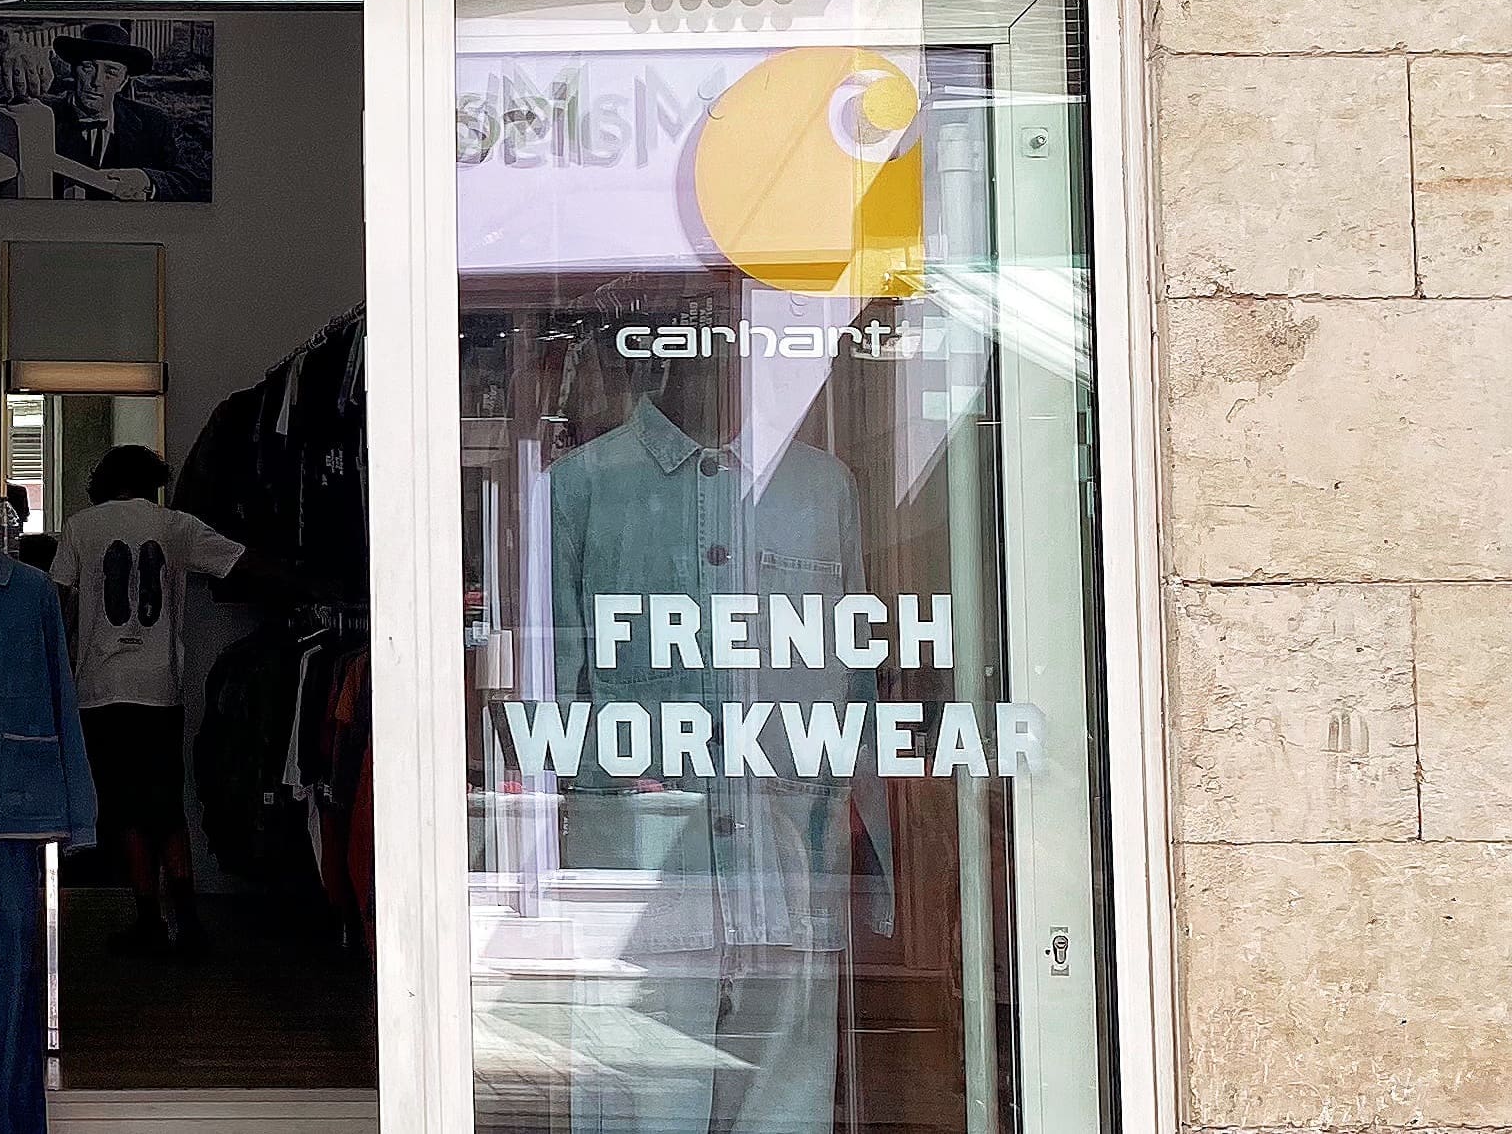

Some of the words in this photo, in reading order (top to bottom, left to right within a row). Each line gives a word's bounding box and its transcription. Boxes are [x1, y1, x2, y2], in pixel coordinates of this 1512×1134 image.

[615, 319, 923, 359] carhartt
[594, 593, 954, 669] FRENCH
[503, 702, 1045, 777] WORKWEAR
